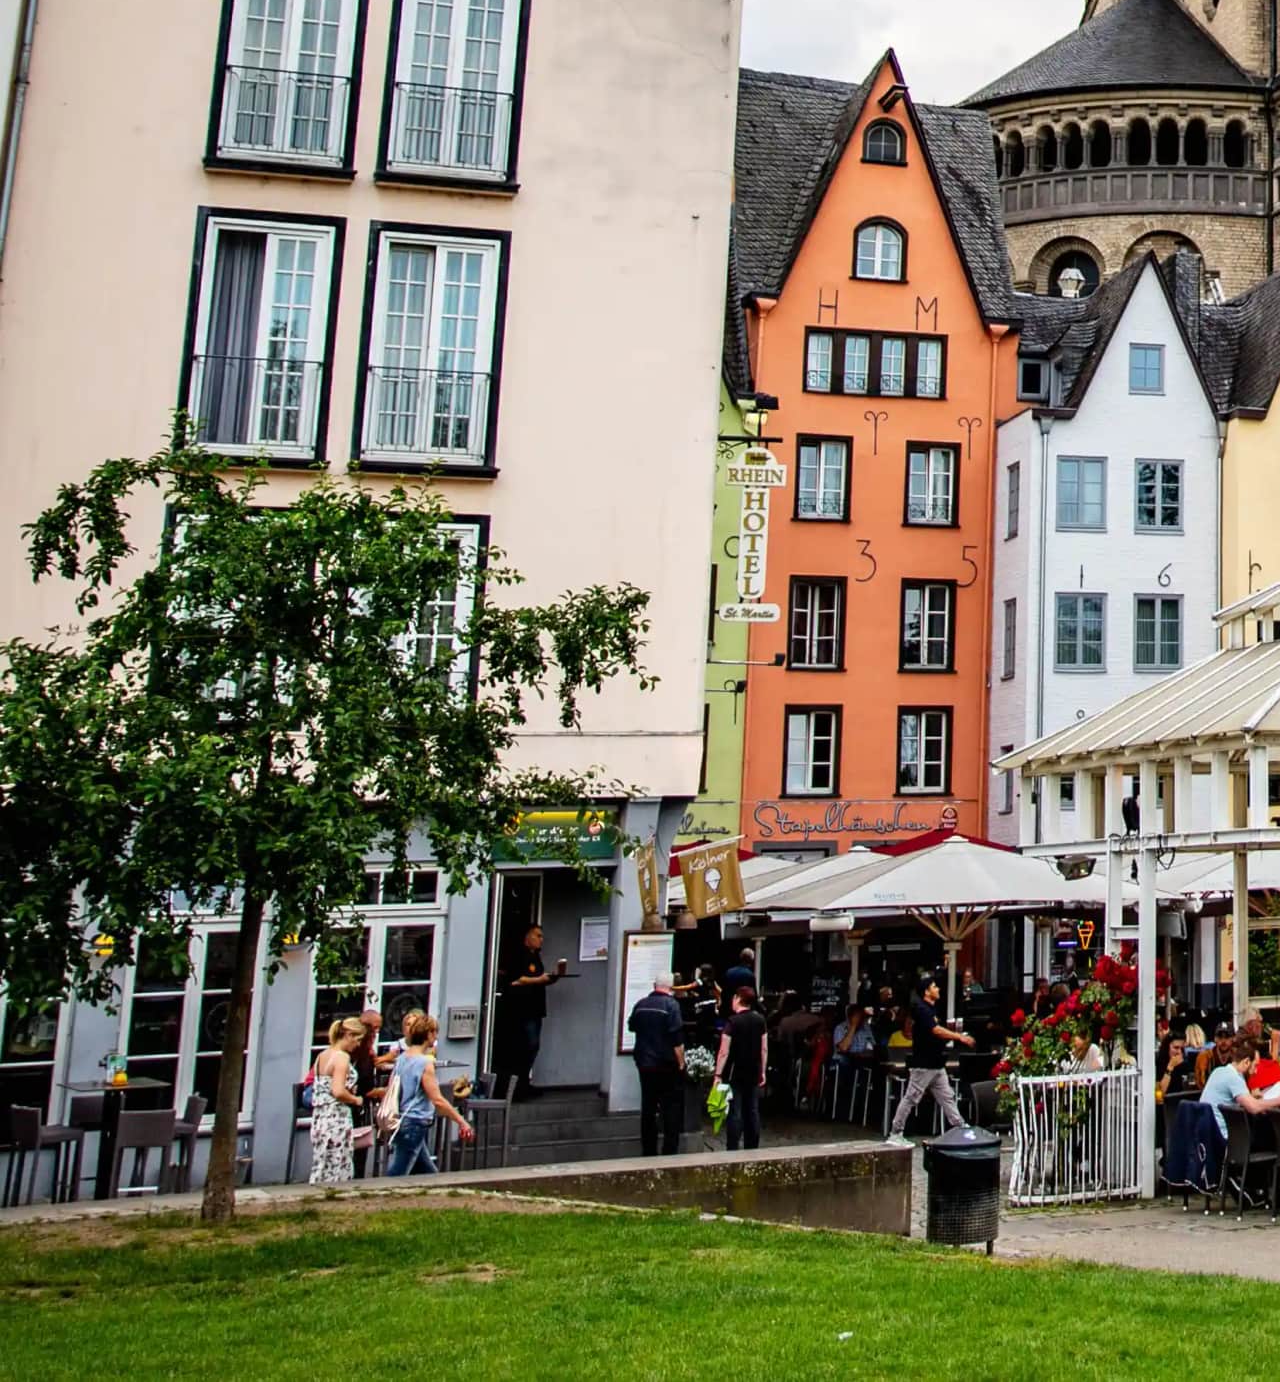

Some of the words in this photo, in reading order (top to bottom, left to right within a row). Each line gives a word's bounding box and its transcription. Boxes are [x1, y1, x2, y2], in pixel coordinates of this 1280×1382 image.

[728, 467, 784, 484] RHEIN
[743, 491, 767, 596] HOTEL
[856, 539, 877, 582] 3
[956, 545, 978, 587] 5
[741, 607, 775, 619] Martin
[754, 802, 931, 841] Stapelhäuschen
